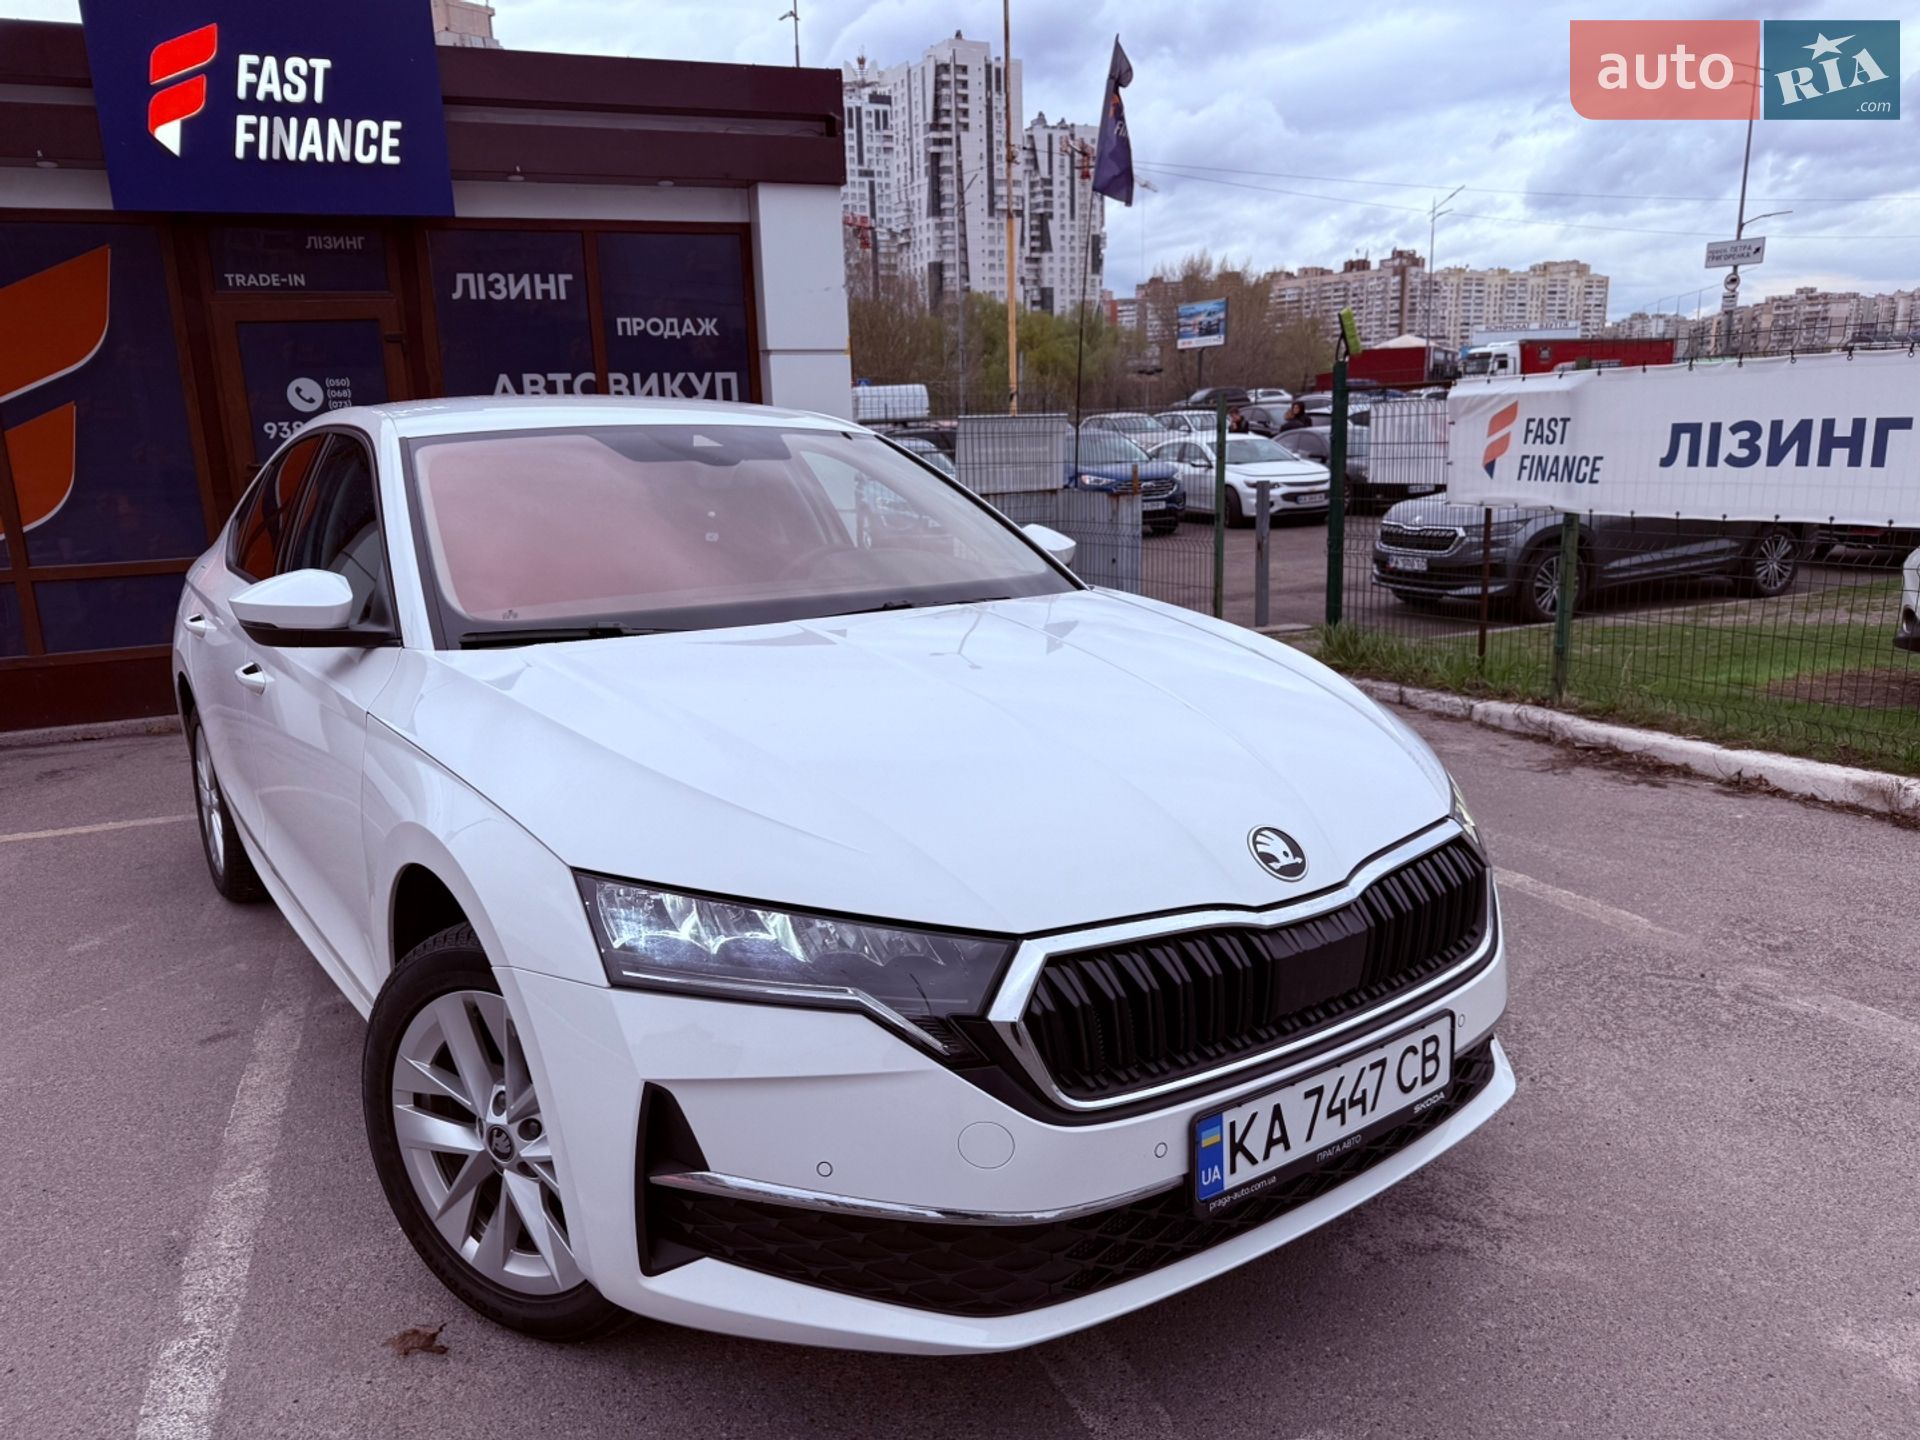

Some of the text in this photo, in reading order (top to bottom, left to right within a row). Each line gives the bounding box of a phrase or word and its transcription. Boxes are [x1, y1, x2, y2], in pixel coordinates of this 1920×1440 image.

[236, 54, 332, 103] FAST
[234, 114, 402, 165] FINANCE
[305, 236, 365, 250] ЛІЗИНГ
[224, 273, 306, 287] TRADE-IN
[452, 272, 573, 300] ЛІЗИНГ
[616, 317, 719, 339] ПРОДАЖ
[1523, 417, 1571, 446] FAST
[1659, 416, 1914, 468] ЛІЗИНГ
[1517, 455, 1604, 485] FINANCE
[1303, 1056, 1388, 1143] 7447
[1317, 1134, 1361, 1162] ПРАГА АВТО
[1201, 1165, 1222, 1186] UA
[1209, 1175, 1277, 1212] praga-auto.com.ua
